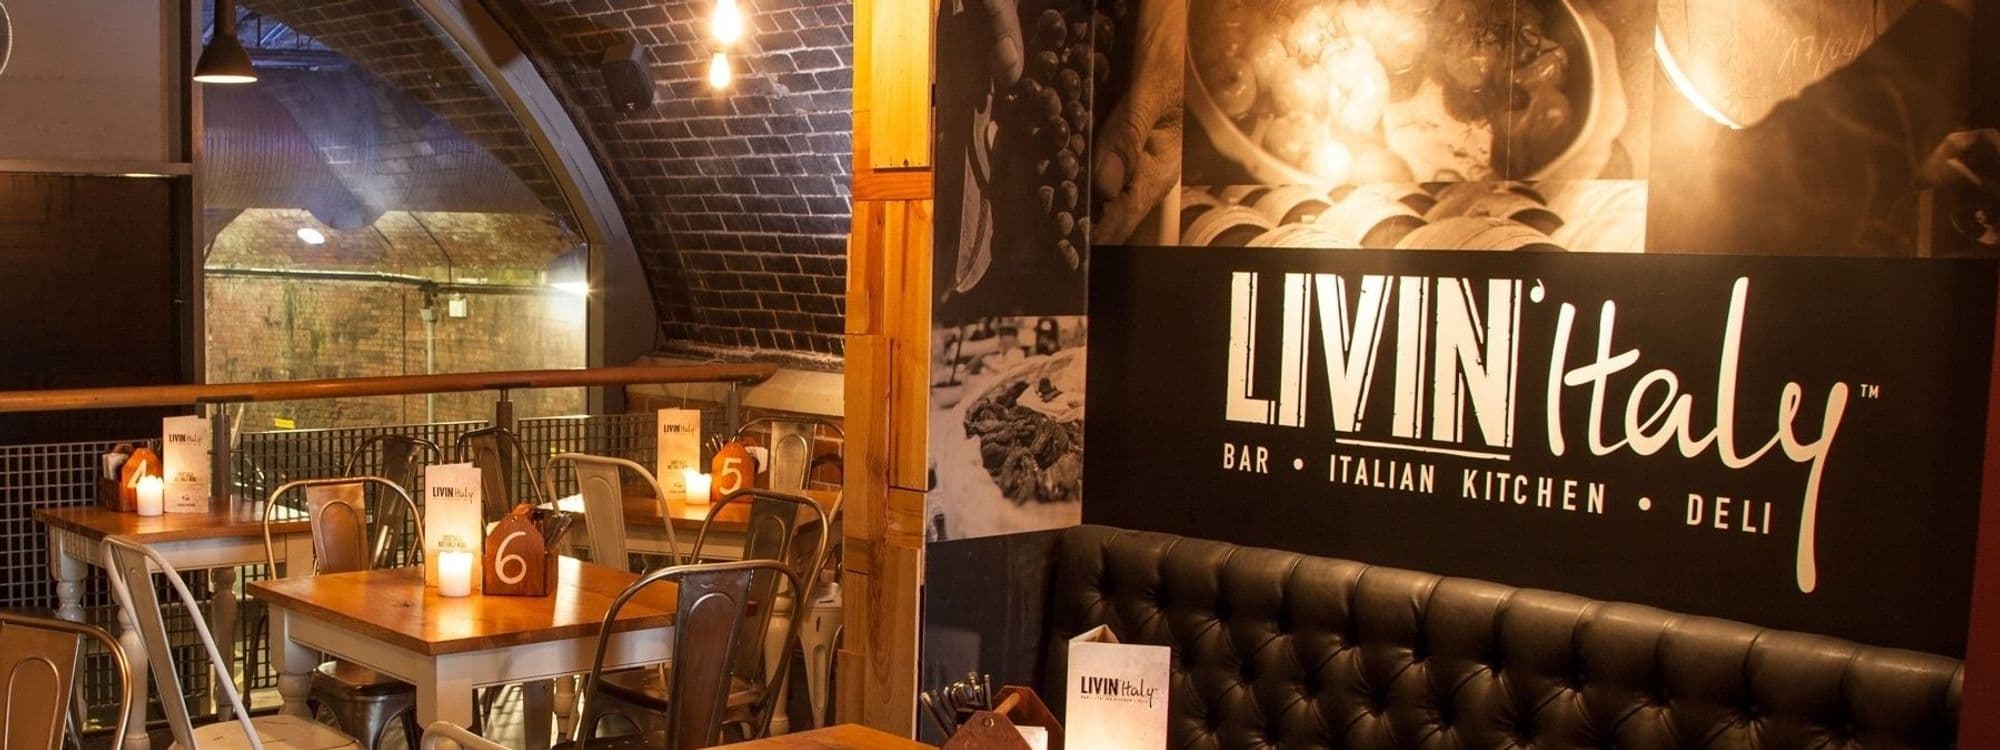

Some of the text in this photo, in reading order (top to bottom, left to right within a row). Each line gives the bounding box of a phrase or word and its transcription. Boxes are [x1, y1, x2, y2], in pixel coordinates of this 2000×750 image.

[1546, 277, 1848, 594] Italy
[126, 458, 148, 489] 4
[720, 457, 743, 496] 5
[1223, 442, 1772, 535] BAR ITALIAN KITCHEN DELI
[495, 531, 527, 585] 6
[1121, 678, 1155, 709] Italy
